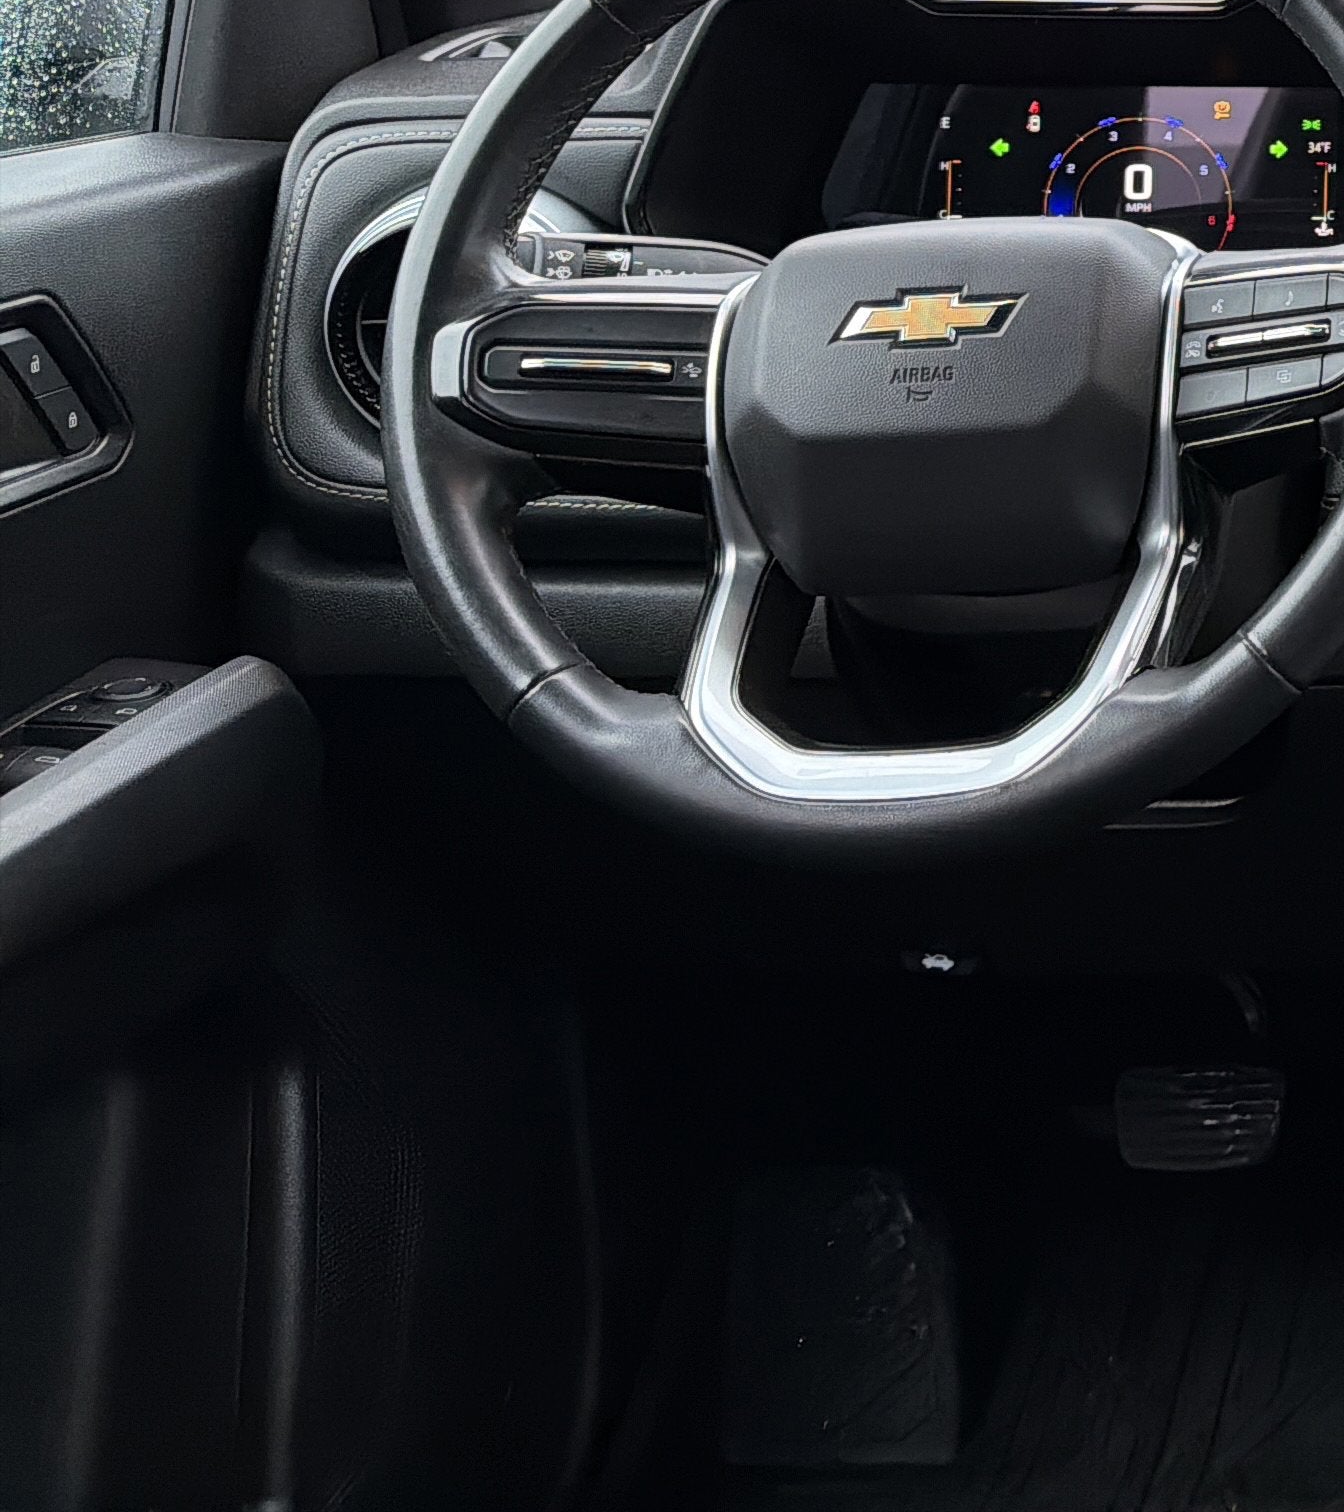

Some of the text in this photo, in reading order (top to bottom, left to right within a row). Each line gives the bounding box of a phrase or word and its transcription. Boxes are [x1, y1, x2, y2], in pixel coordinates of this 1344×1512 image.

[1108, 131, 1118, 142] 3
[1163, 131, 1173, 141] 4
[1065, 163, 1076, 174] 2
[1123, 163, 1153, 201] 0
[1125, 203, 1152, 213] MPH
[889, 365, 954, 384] AIRBAG
